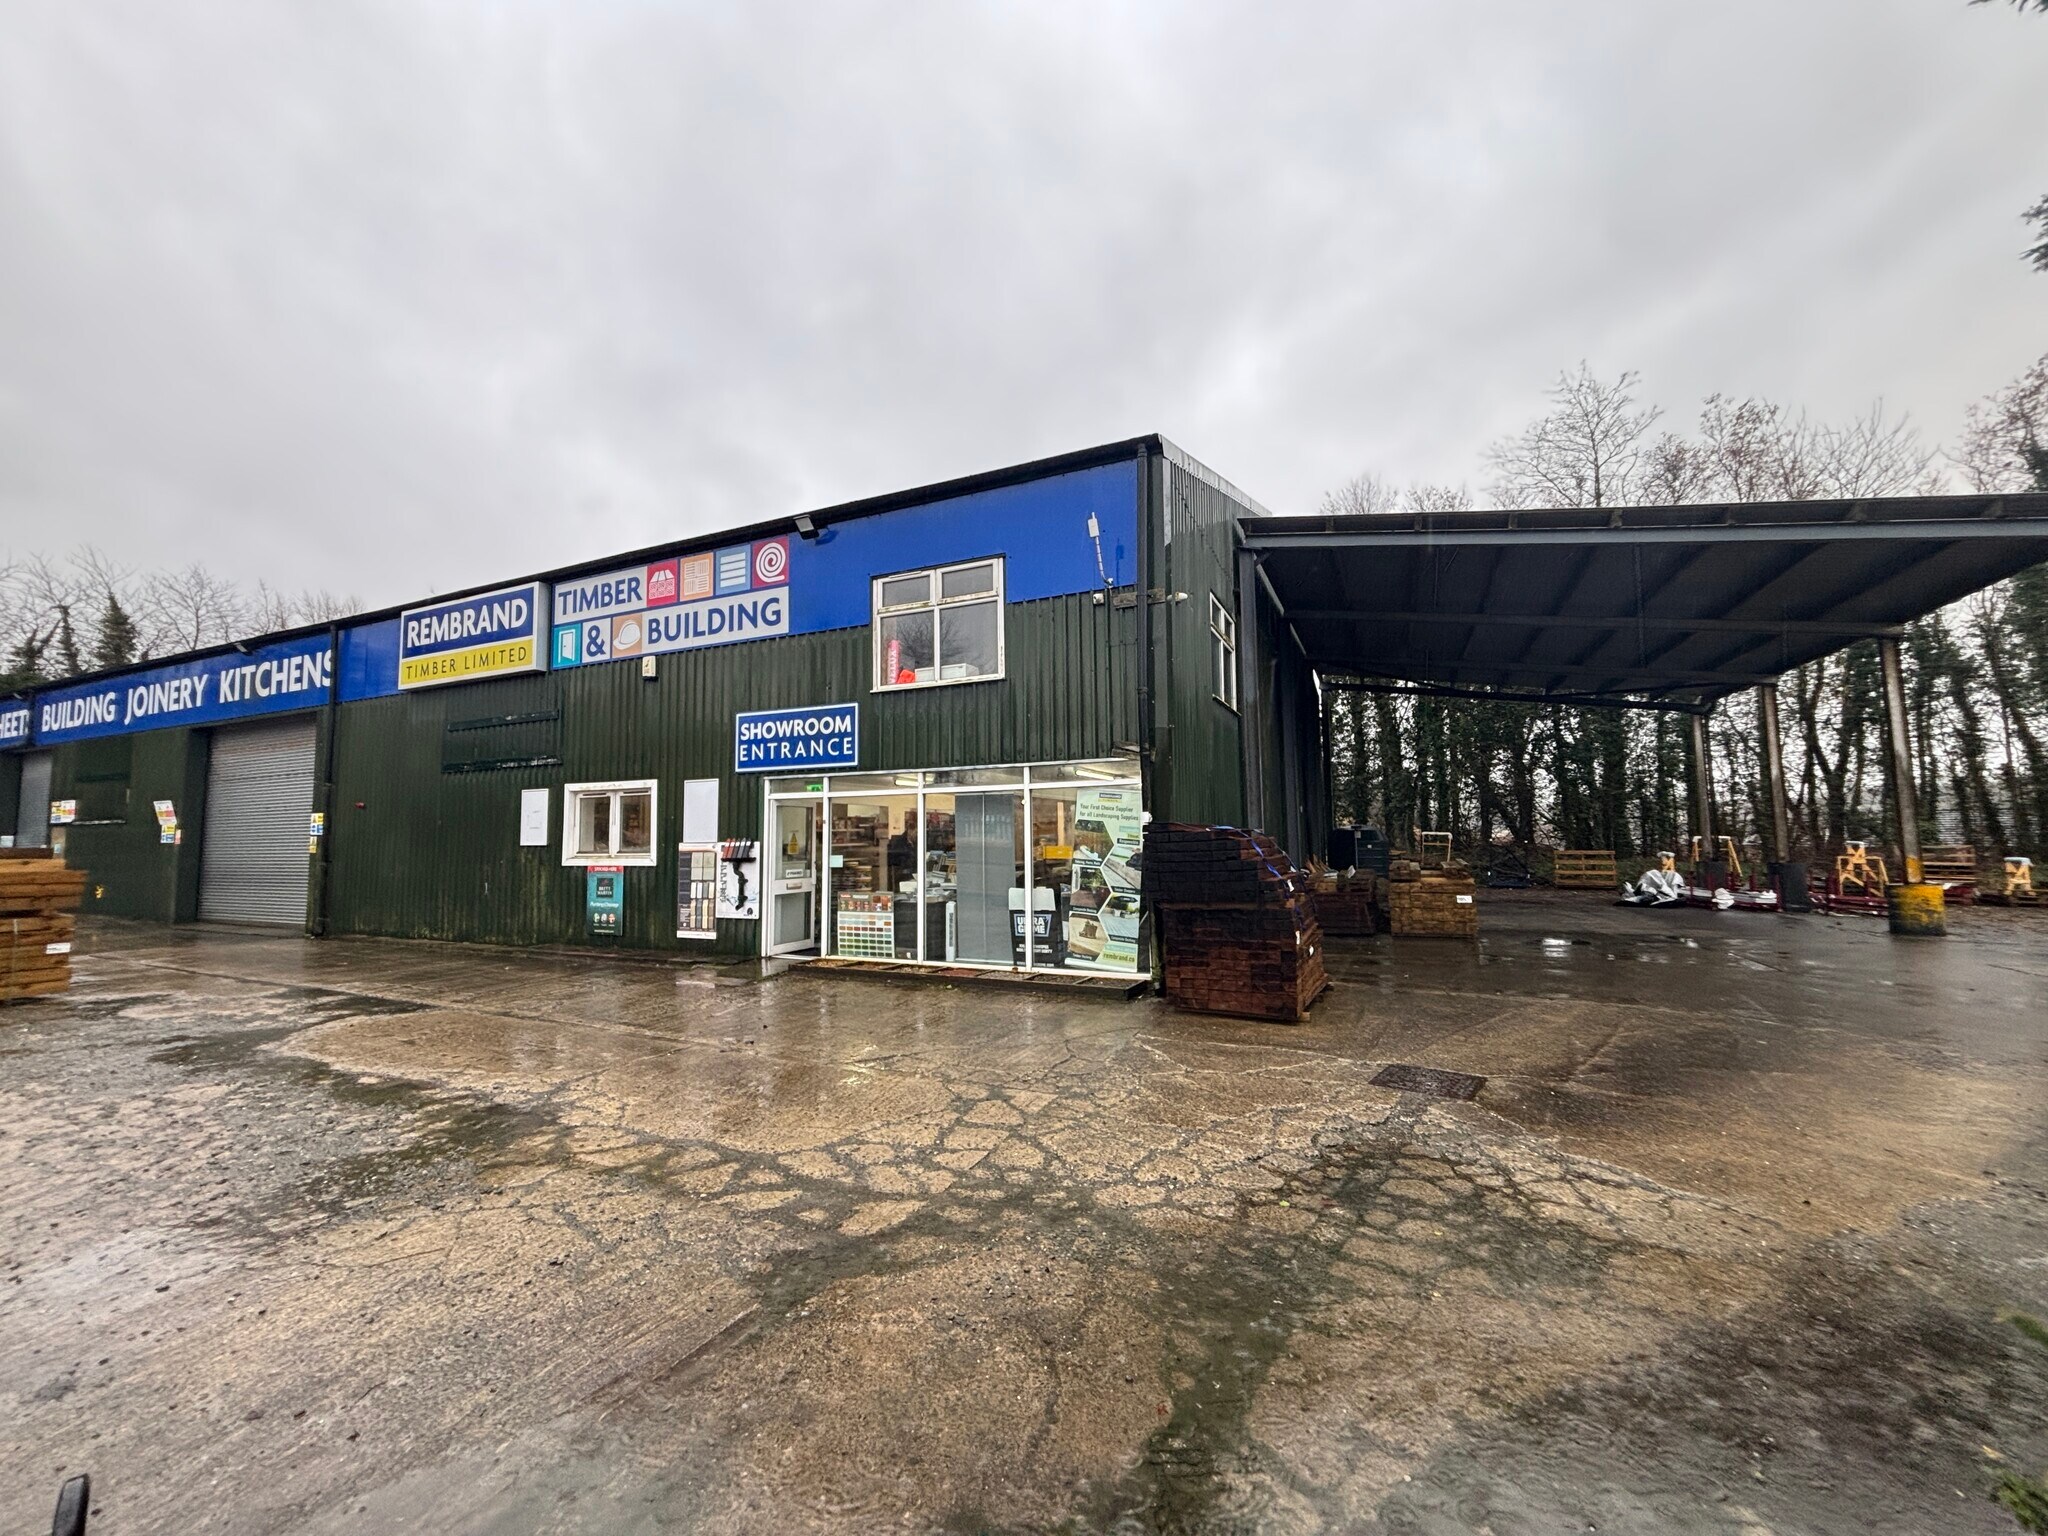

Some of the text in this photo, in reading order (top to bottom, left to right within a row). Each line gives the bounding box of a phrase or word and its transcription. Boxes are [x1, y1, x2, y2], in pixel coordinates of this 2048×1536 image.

[558, 576, 643, 616] TIMBER
[407, 598, 528, 648] REMBRAND
[586, 597, 782, 657] & BUILDING
[406, 646, 527, 680] TIMBER LIMITED
[41, 691, 116, 732] BUILDING
[124, 673, 209, 725] JOINERY
[740, 715, 852, 741] SHOWROOM
[739, 737, 853, 761] ENTRANCE
[1017, 916, 1045, 926] URA
